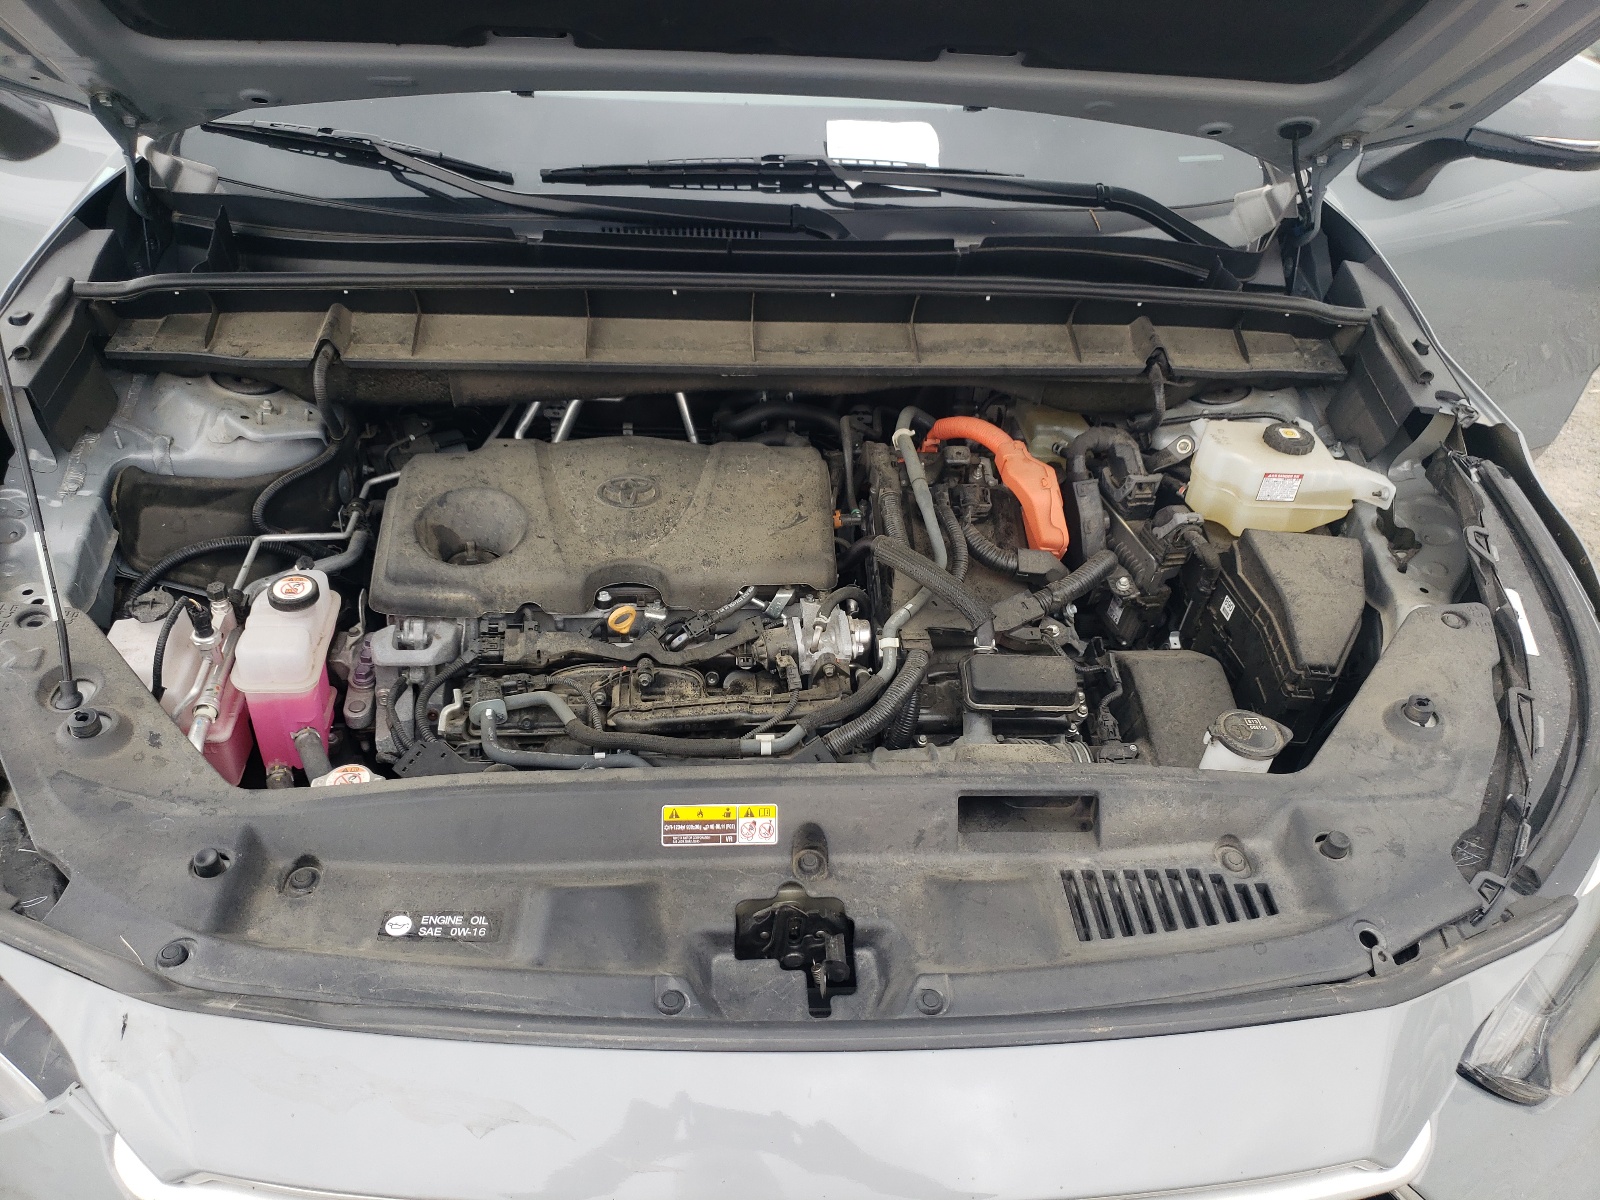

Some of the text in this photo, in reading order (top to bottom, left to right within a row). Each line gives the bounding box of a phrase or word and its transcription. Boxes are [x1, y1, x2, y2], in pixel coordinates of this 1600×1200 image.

[421, 915, 489, 925] ENGINE OIL
[418, 927, 486, 936] SAE 0W-16
